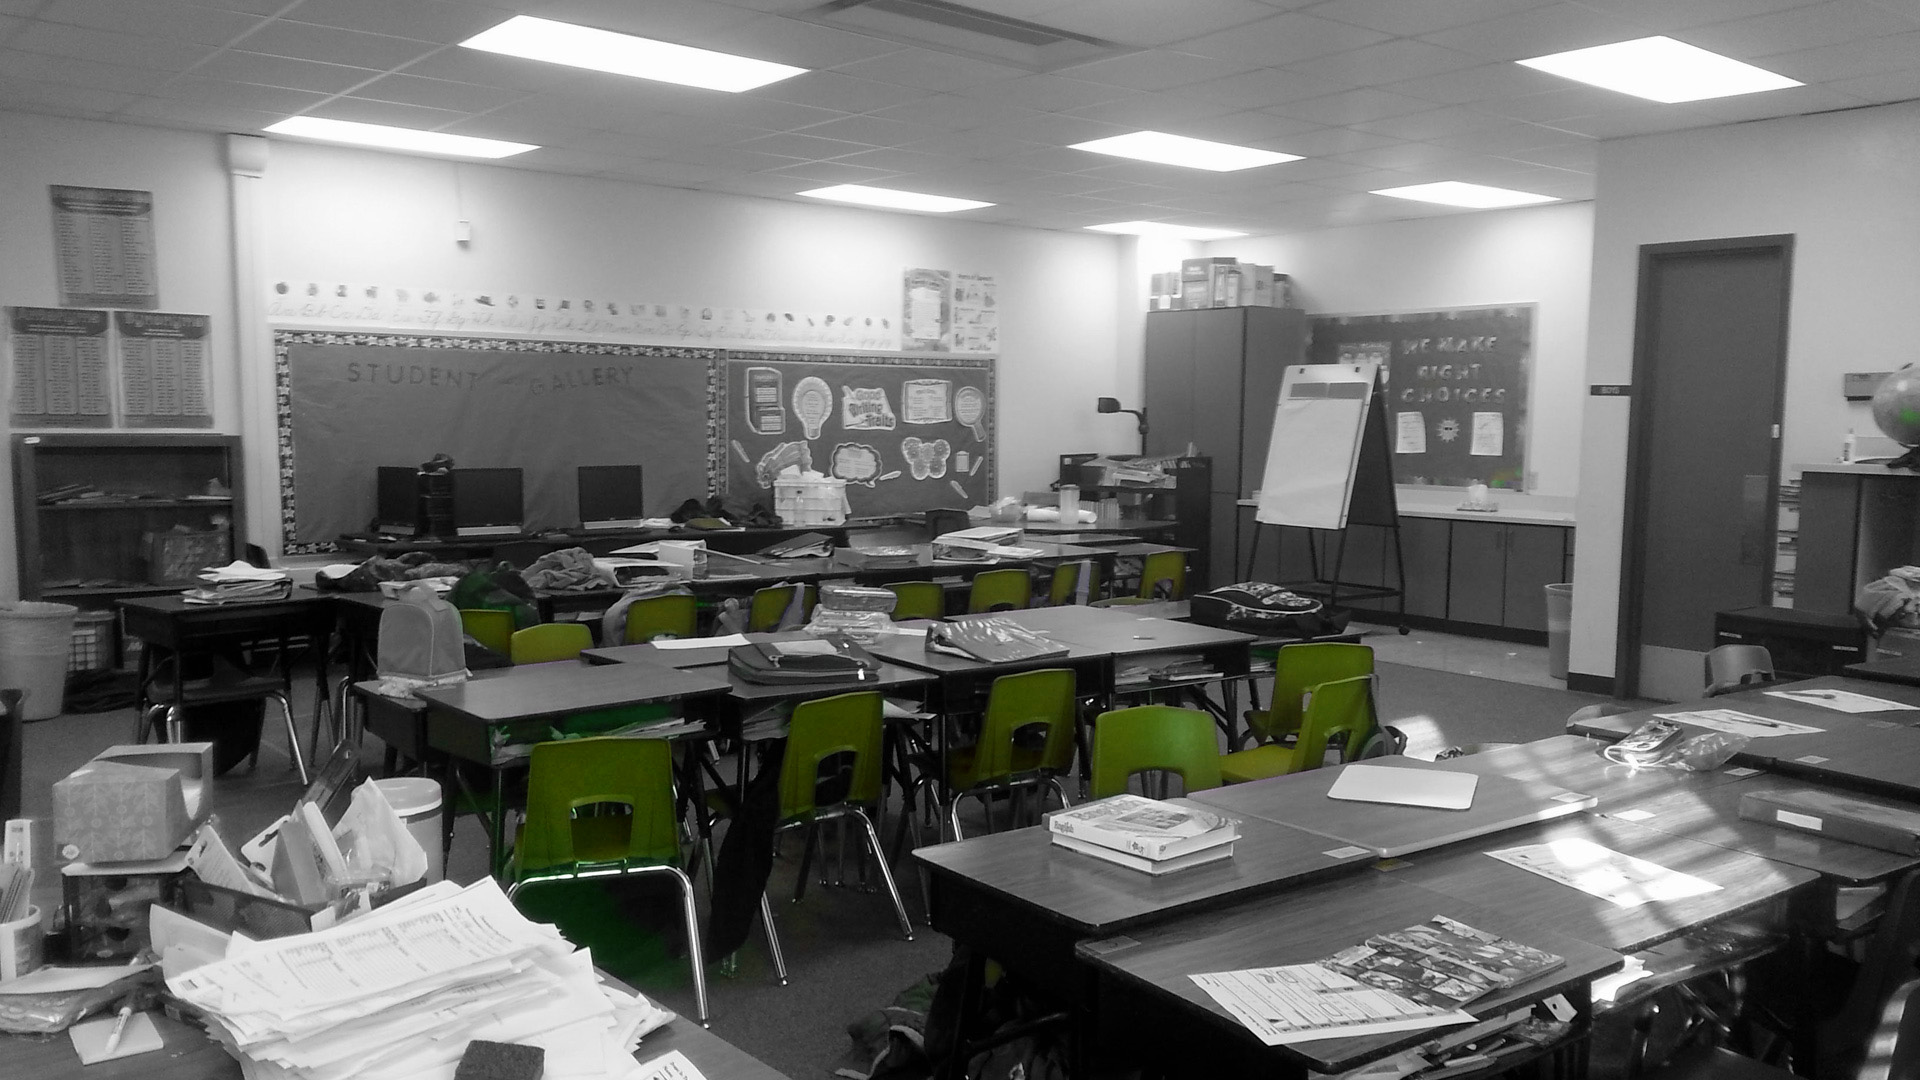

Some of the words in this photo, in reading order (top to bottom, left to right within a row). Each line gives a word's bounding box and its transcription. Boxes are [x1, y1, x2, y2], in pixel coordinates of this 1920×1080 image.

[1402, 337, 1430, 354] WE
[1436, 336, 1497, 352] MAKE
[346, 362, 481, 391] STUDENT
[530, 366, 634, 396] GALLERY
[1416, 363, 1482, 380] RIGHT
[1402, 386, 1506, 403] CHOICES
[865, 413, 896, 428] Traits
